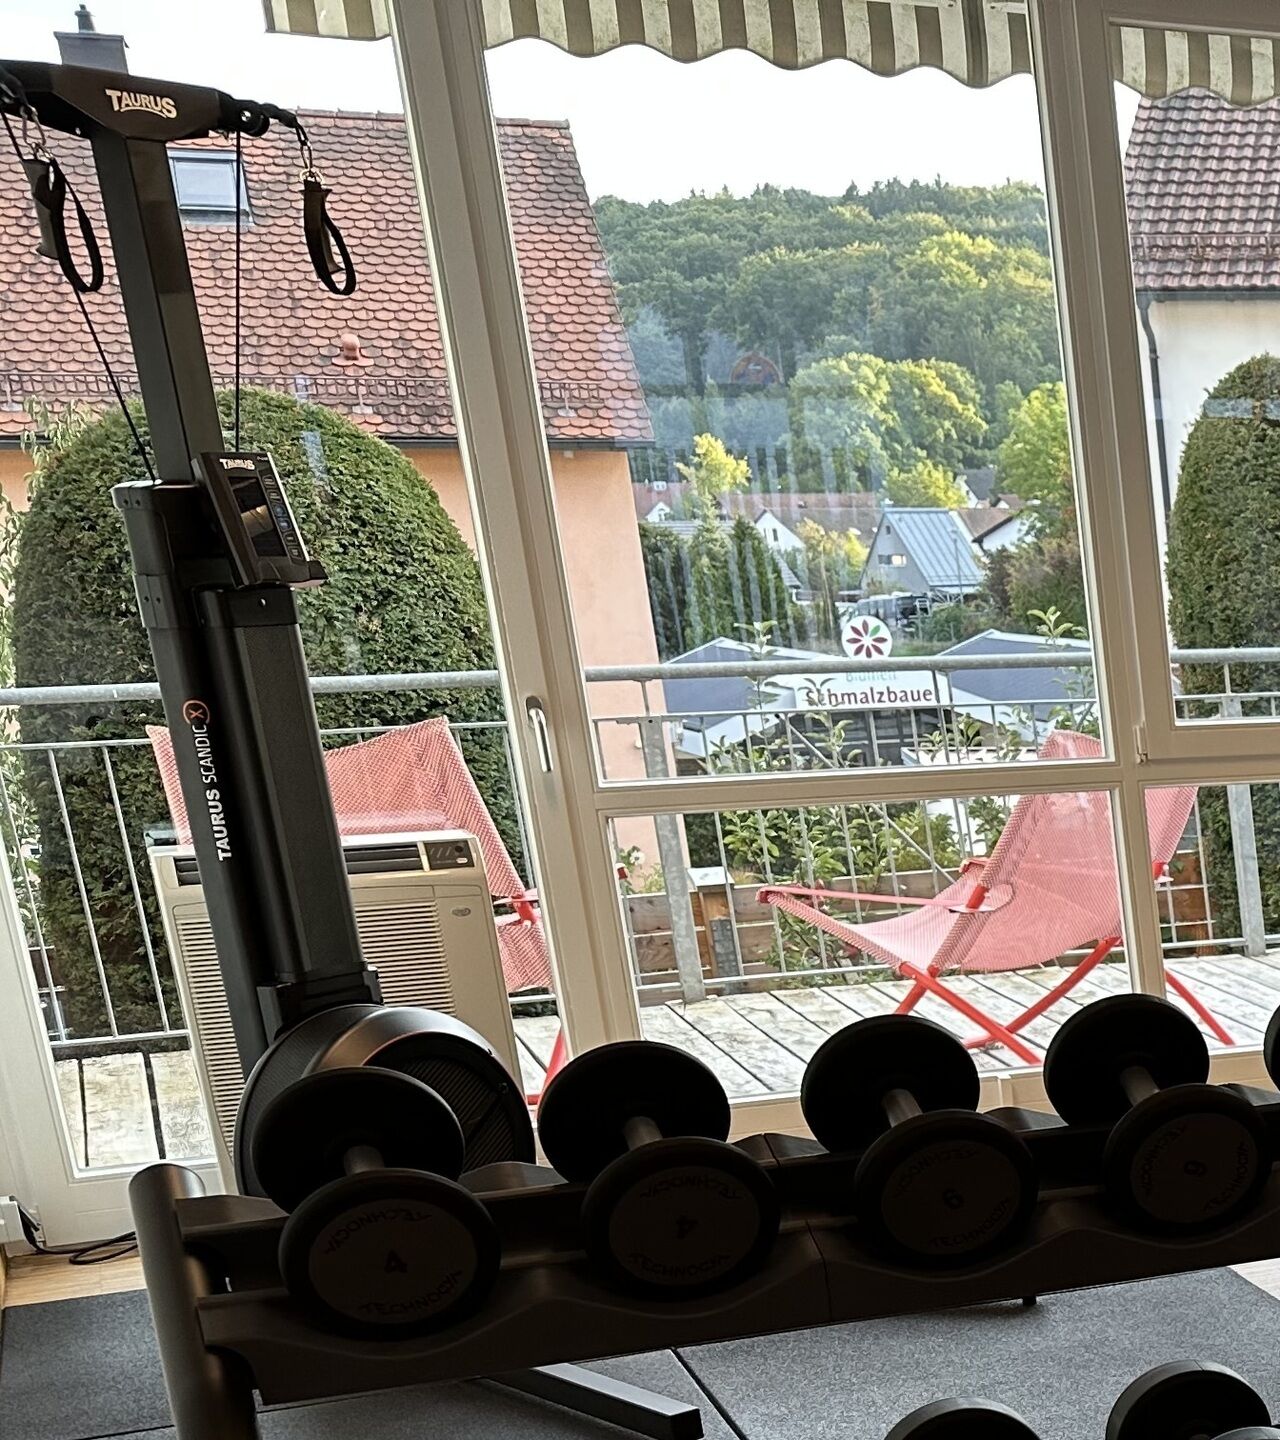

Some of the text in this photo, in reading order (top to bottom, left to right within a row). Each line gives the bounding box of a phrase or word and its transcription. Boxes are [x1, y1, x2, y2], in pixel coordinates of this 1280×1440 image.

[105, 89, 177, 118] TAURUS
[192, 724, 217, 783] SCANDIC
[206, 789, 232, 861] TAURUS
[385, 1250, 408, 1273] 4
